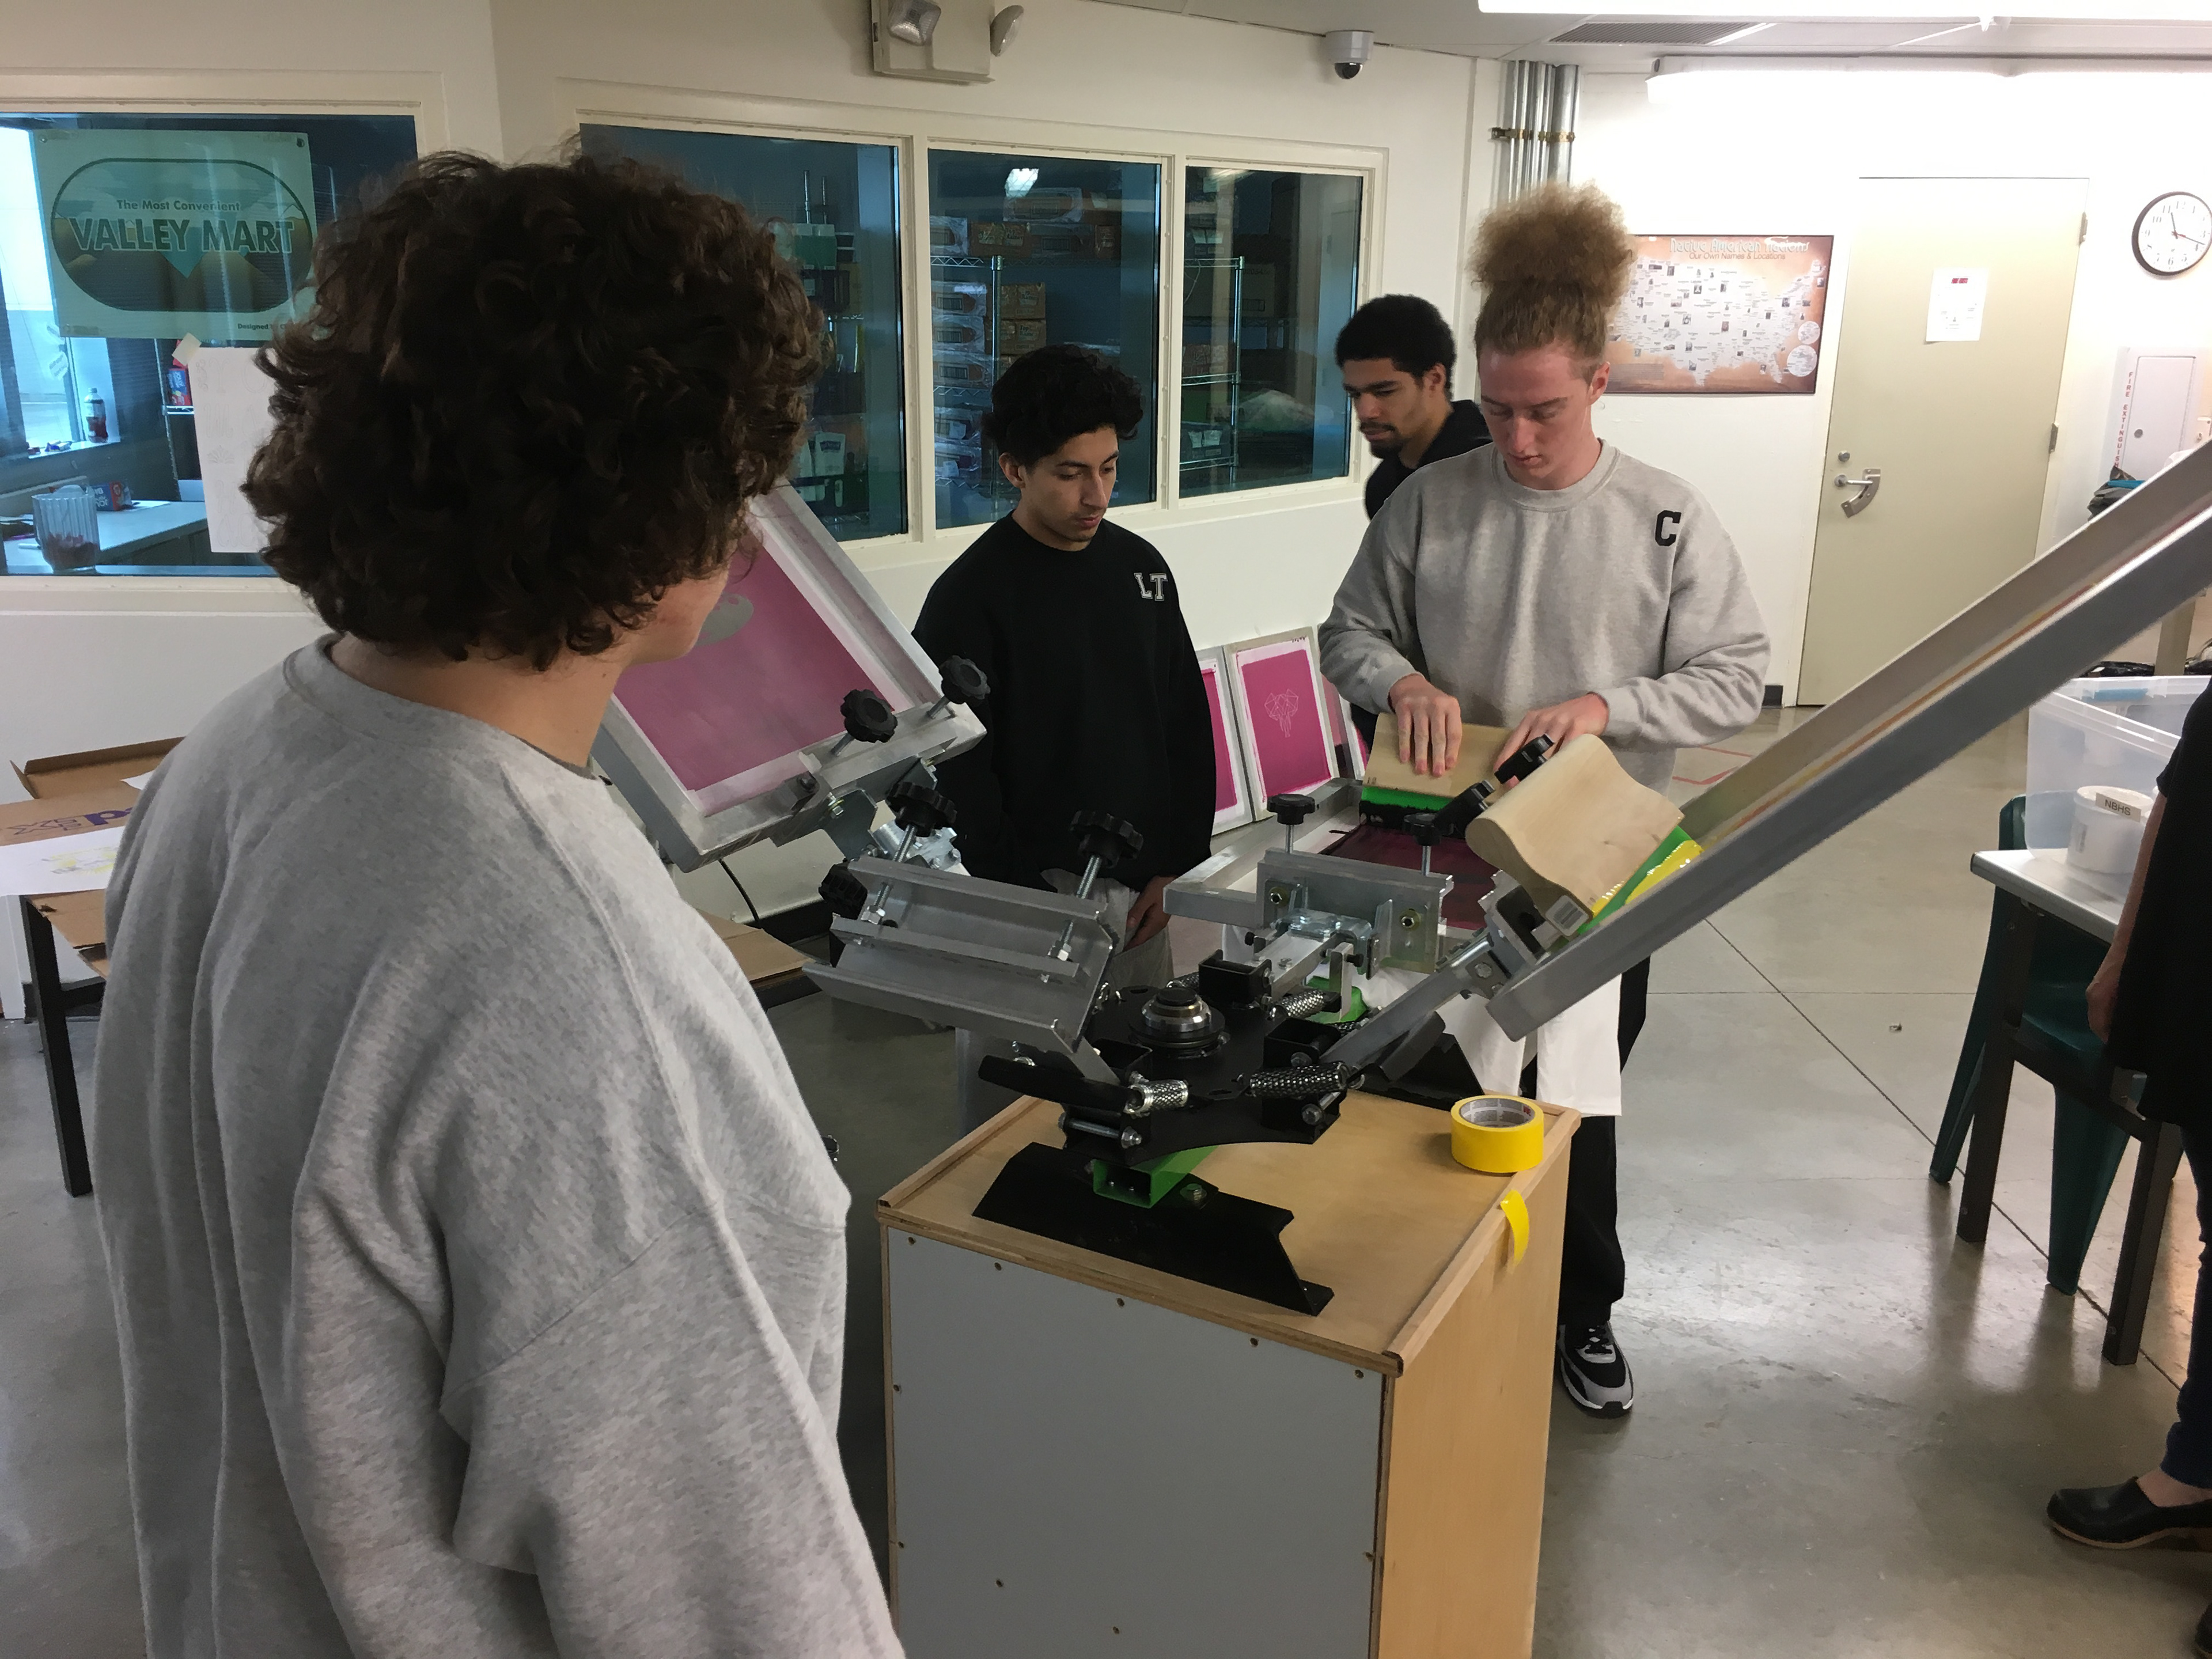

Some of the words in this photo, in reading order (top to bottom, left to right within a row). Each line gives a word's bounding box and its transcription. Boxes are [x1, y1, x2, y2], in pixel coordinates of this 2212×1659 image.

[116, 200, 139, 210] The
[142, 200, 169, 210] Most
[173, 200, 240, 211] Convenient
[69, 218, 191, 251] VALLEY
[201, 219, 295, 253] MART
[1669, 237, 1707, 253] Native
[1710, 238, 1762, 253] American
[2125, 372, 2133, 397] FIRE
[1655, 510, 1681, 547] C
[1133, 572, 1168, 601] LT
[2104, 799, 2131, 816] NBHS
